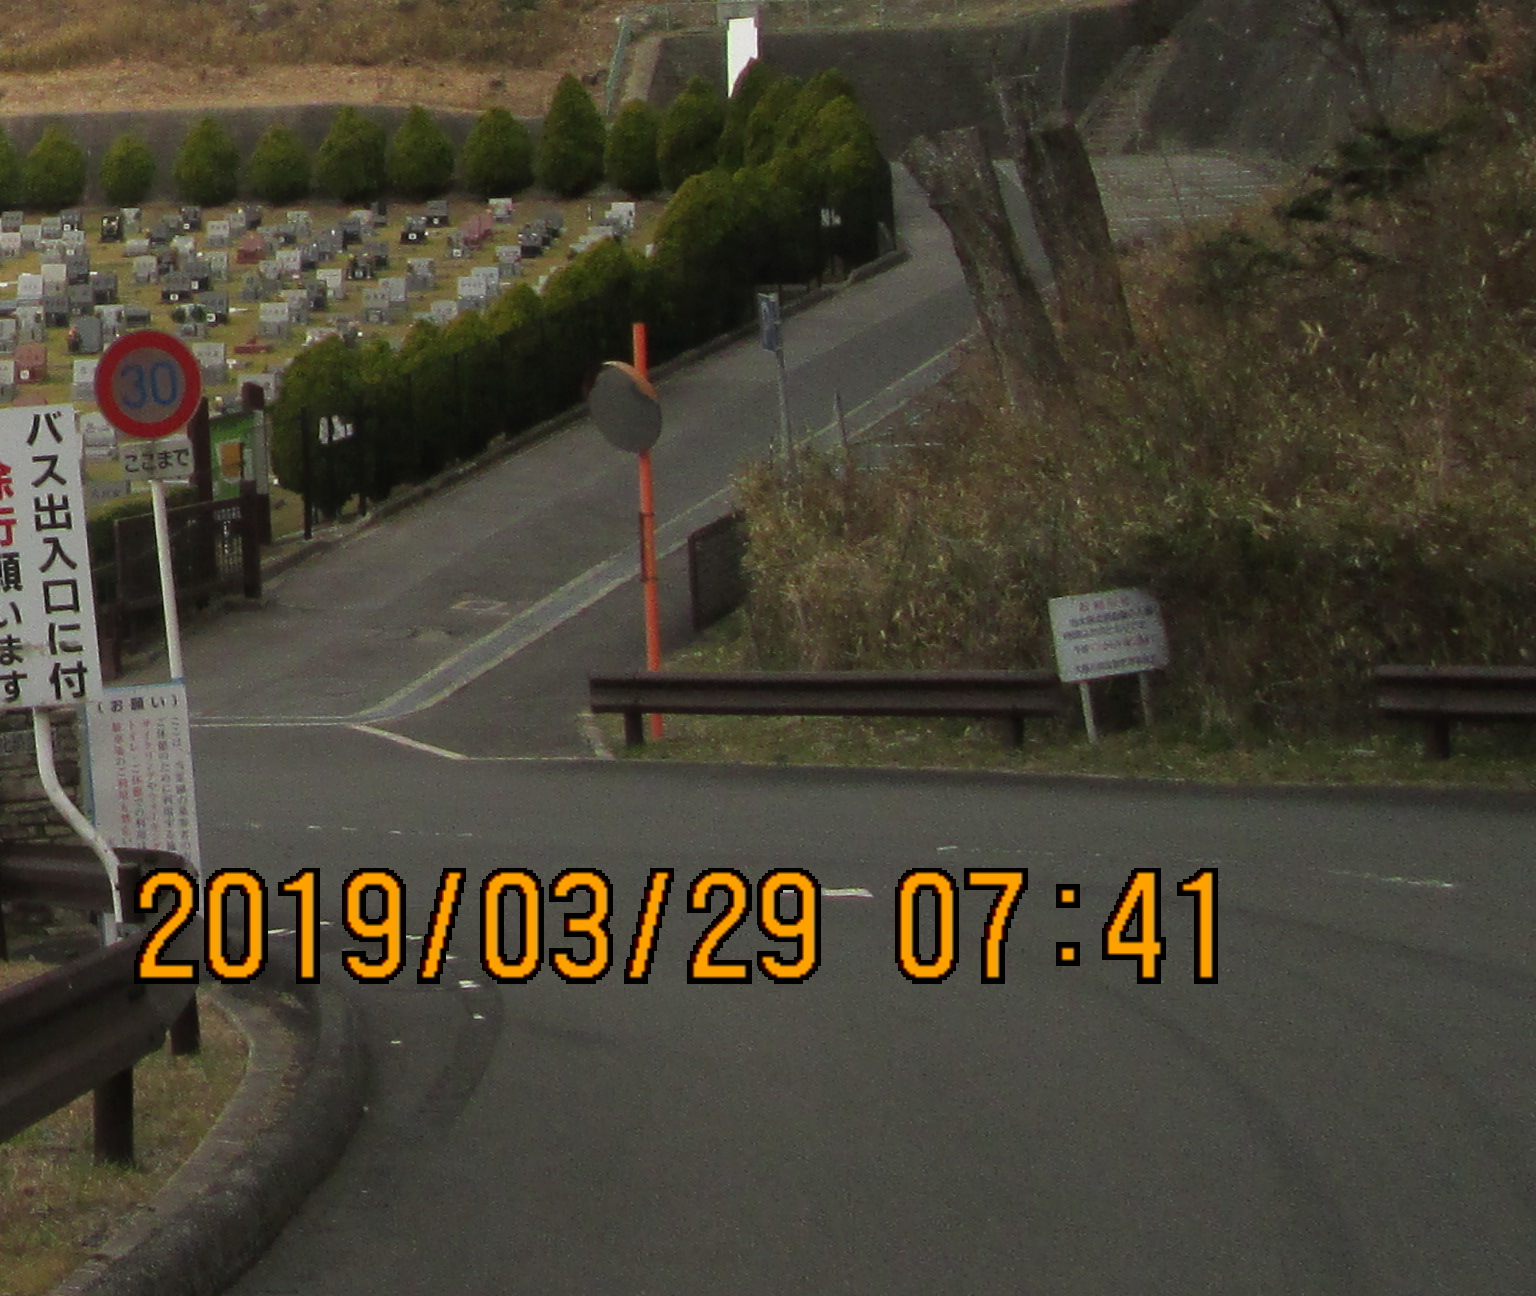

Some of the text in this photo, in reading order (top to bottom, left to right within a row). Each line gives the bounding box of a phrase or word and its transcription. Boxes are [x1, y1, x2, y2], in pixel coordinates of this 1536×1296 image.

[120, 360, 178, 409] 30
[124, 447, 190, 473] ここまで
[26, 410, 89, 700] バス出入口に付
